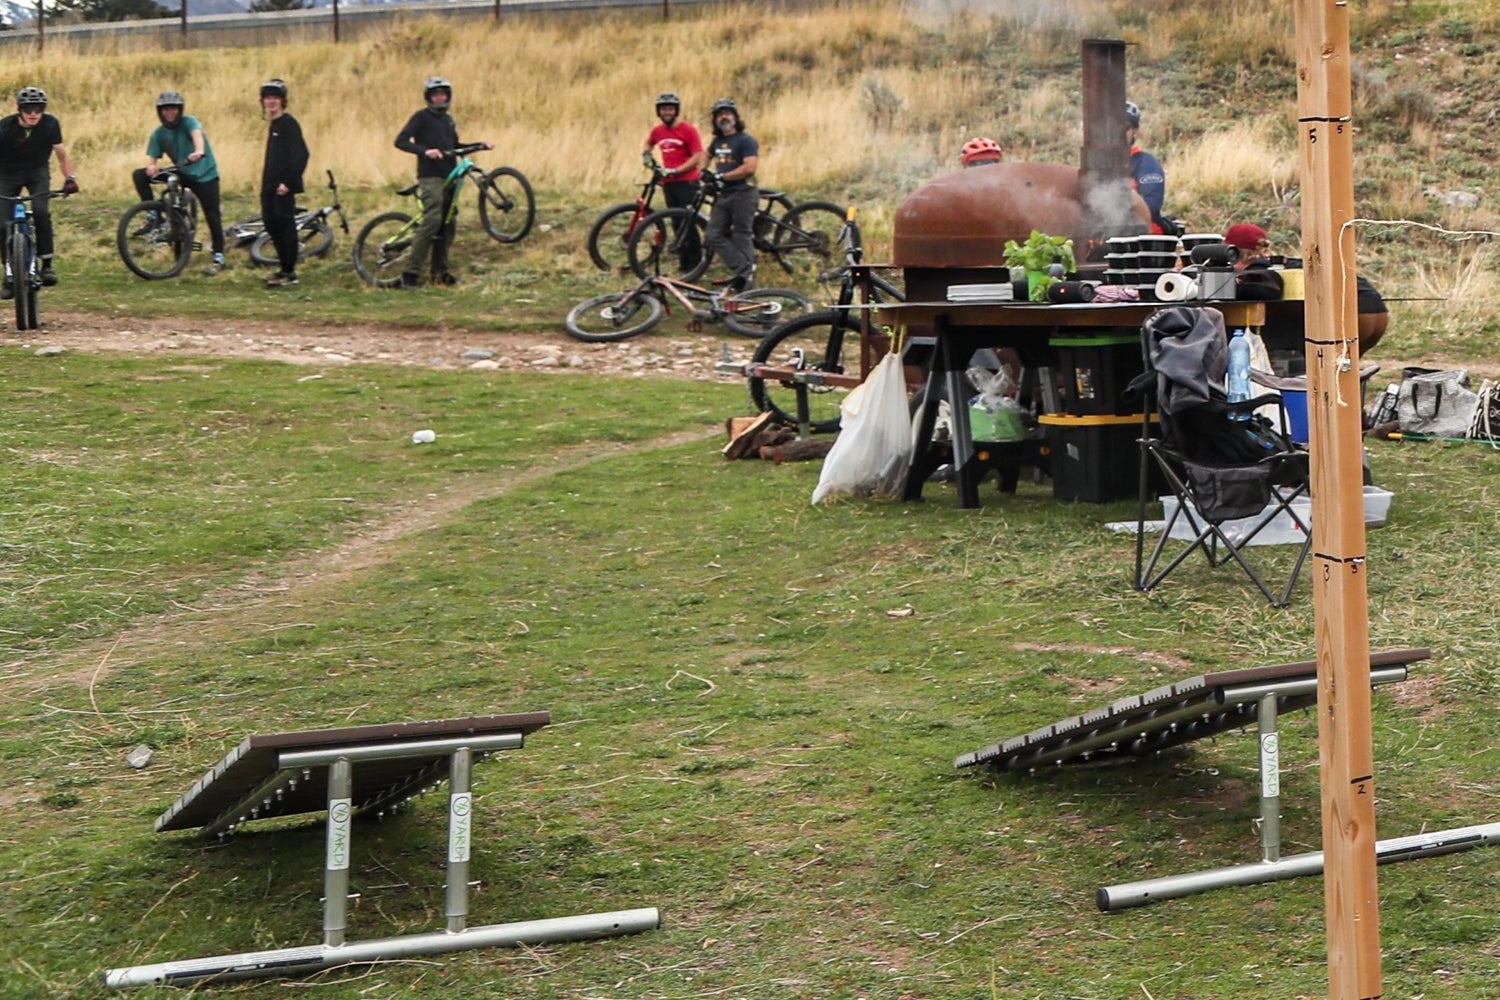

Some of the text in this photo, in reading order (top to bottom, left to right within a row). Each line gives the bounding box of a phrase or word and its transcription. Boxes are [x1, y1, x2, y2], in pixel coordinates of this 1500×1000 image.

[1309, 127, 1317, 144] 5
[1337, 124, 1343, 134] 5
[1316, 347, 1324, 369] 4
[1322, 563, 1330, 582] 3
[1357, 784, 1367, 795] 2
